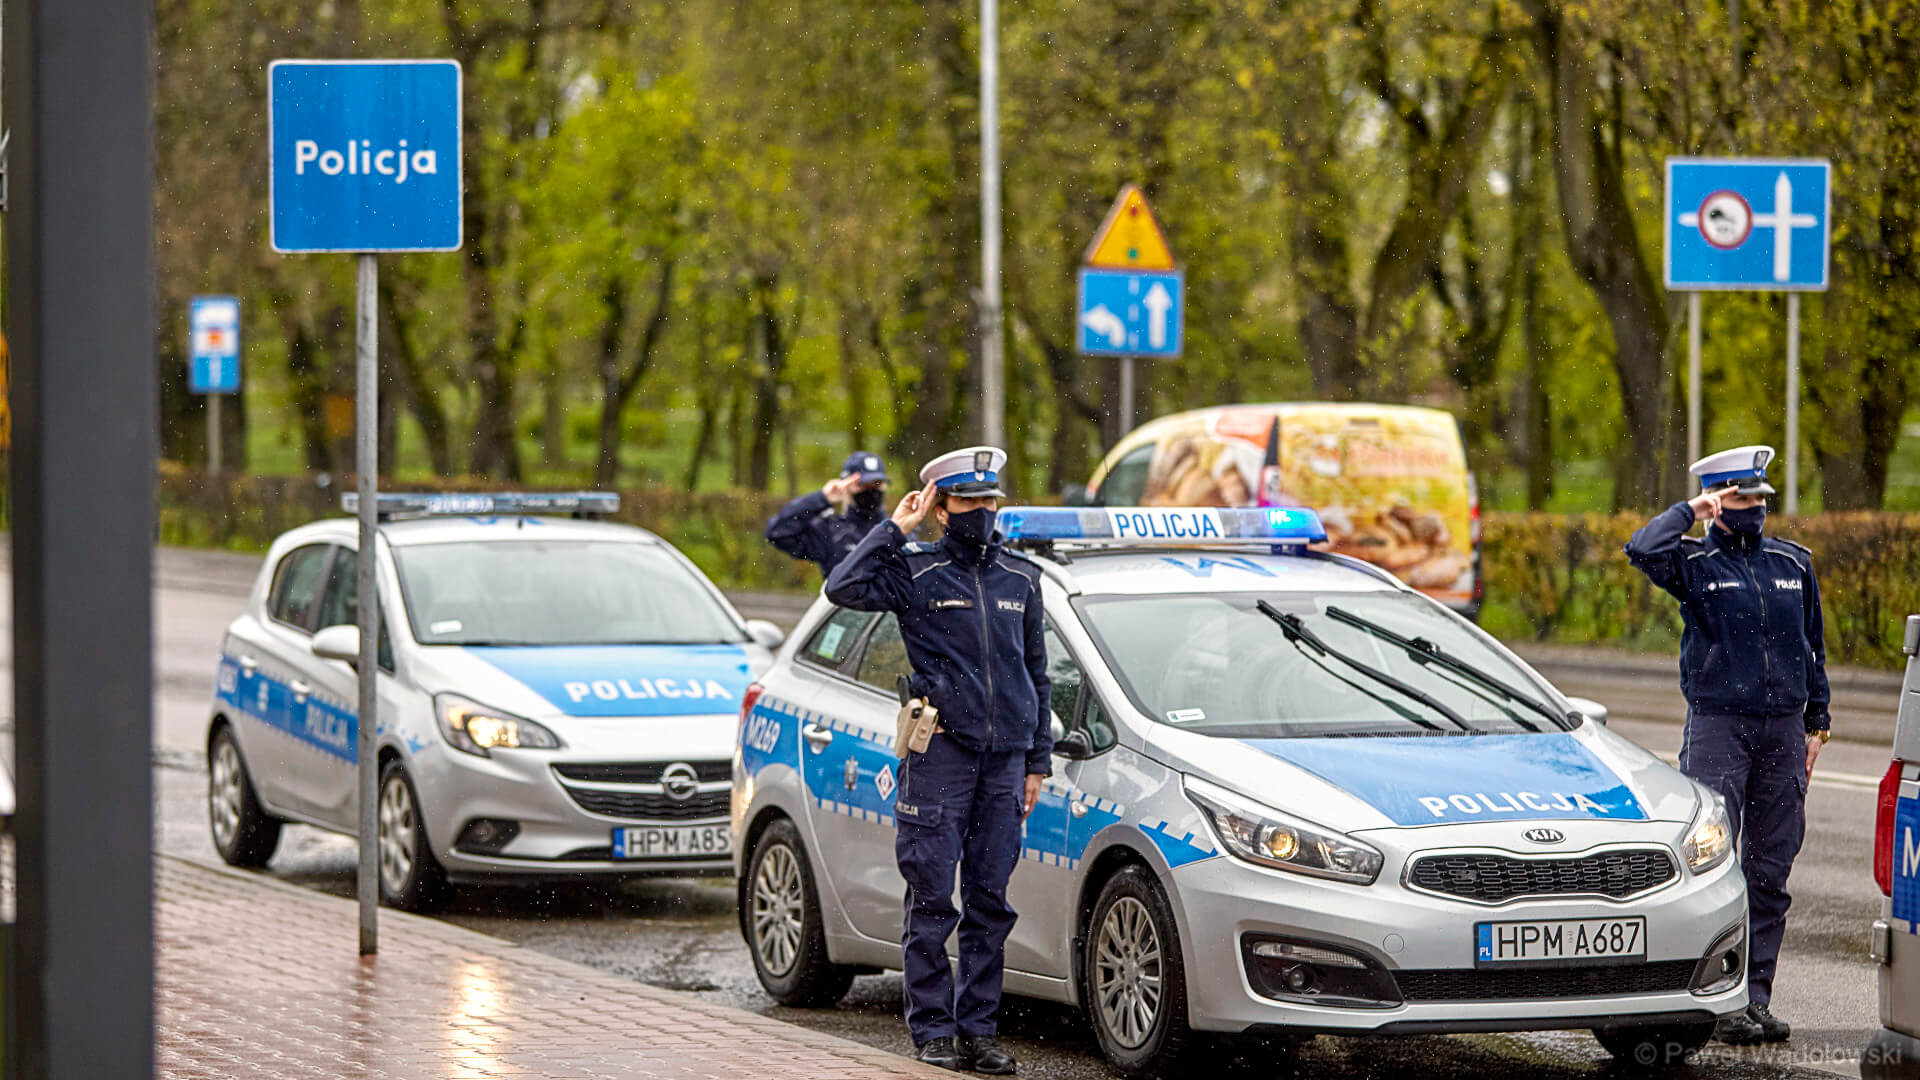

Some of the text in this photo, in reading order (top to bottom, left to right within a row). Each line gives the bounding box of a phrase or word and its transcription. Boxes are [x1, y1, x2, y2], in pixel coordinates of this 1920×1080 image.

[295, 139, 437, 184] Policja
[1114, 513, 1219, 537] POLICJA
[997, 600, 1025, 613] POLICJ
[564, 678, 734, 703] POLICJA
[746, 713, 781, 754] M269
[1418, 792, 1609, 817] POLICJA
[628, 828, 733, 853] HPM A85
[1529, 829, 1562, 842] KIA
[1479, 946, 1491, 957] PL
[1498, 922, 1640, 958] HPM A687
